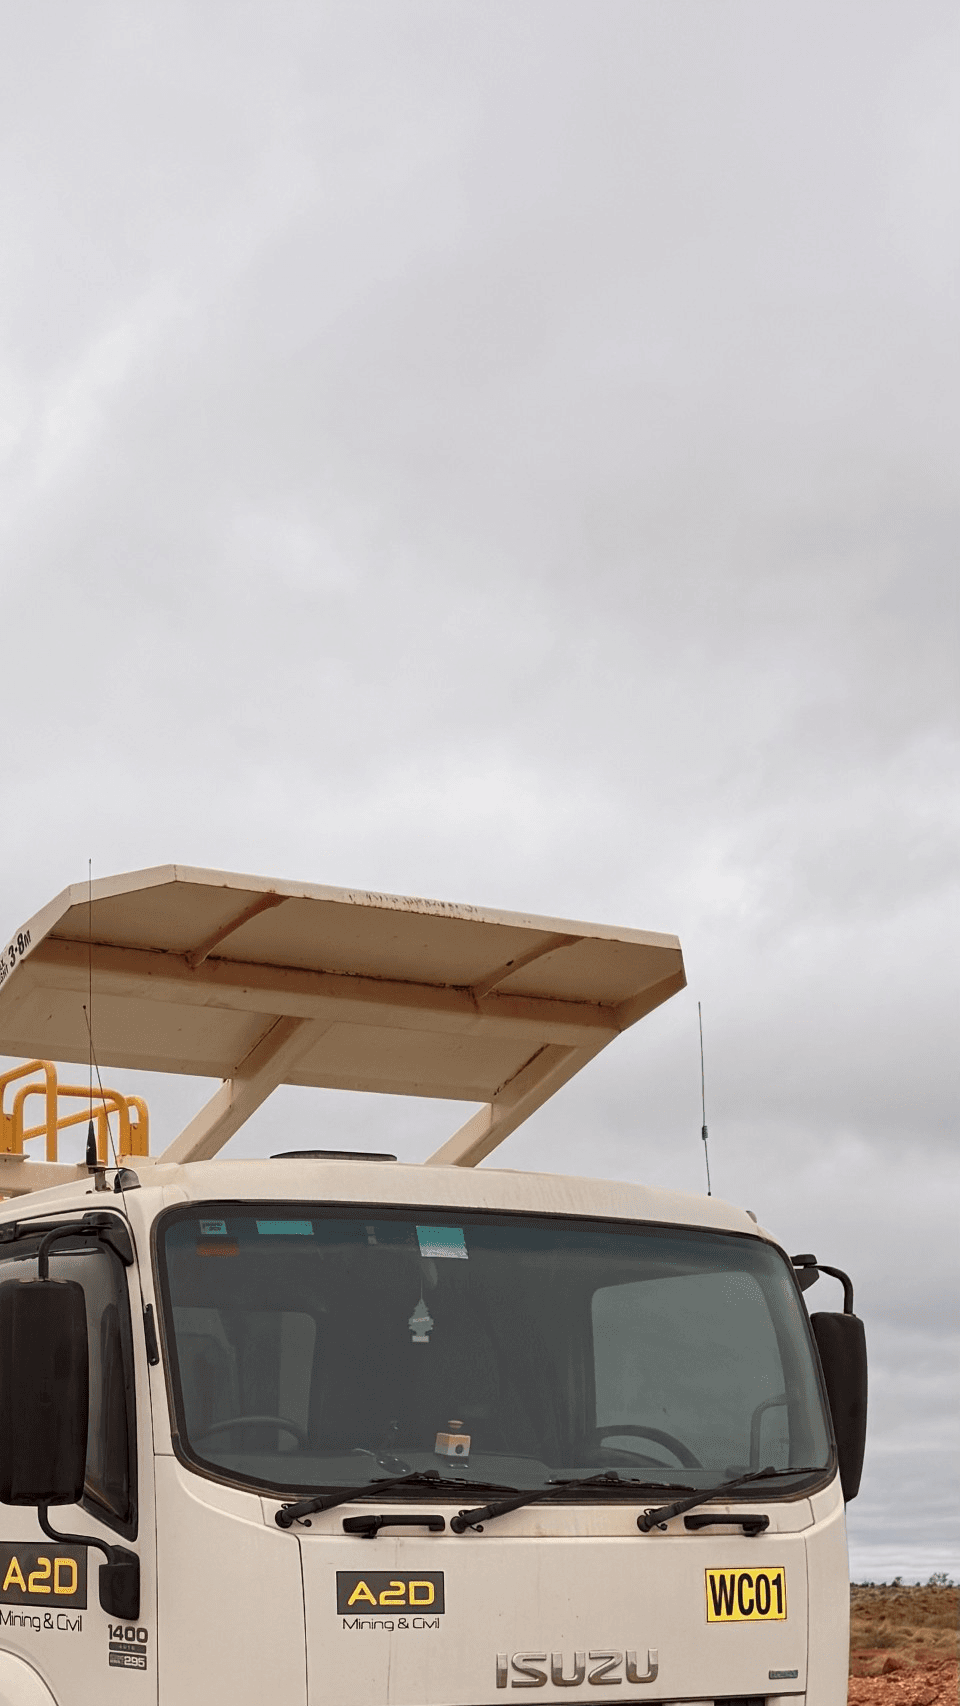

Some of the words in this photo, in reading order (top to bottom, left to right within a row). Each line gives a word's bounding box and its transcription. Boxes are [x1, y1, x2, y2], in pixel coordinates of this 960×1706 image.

[2, 1556, 78, 1595] A2D
[347, 1580, 435, 1606] A2D
[709, 1572, 784, 1617] WC01
[0, 1609, 41, 1633] Mining
[43, 1612, 55, 1630] &
[56, 1613, 83, 1633] Civil
[107, 1623, 149, 1644] 1400
[342, 1617, 395, 1632] Mining
[397, 1617, 410, 1629] &
[412, 1617, 440, 1629] Civil
[124, 1655, 146, 1668] 295
[495, 1648, 659, 1689] ISUZU
